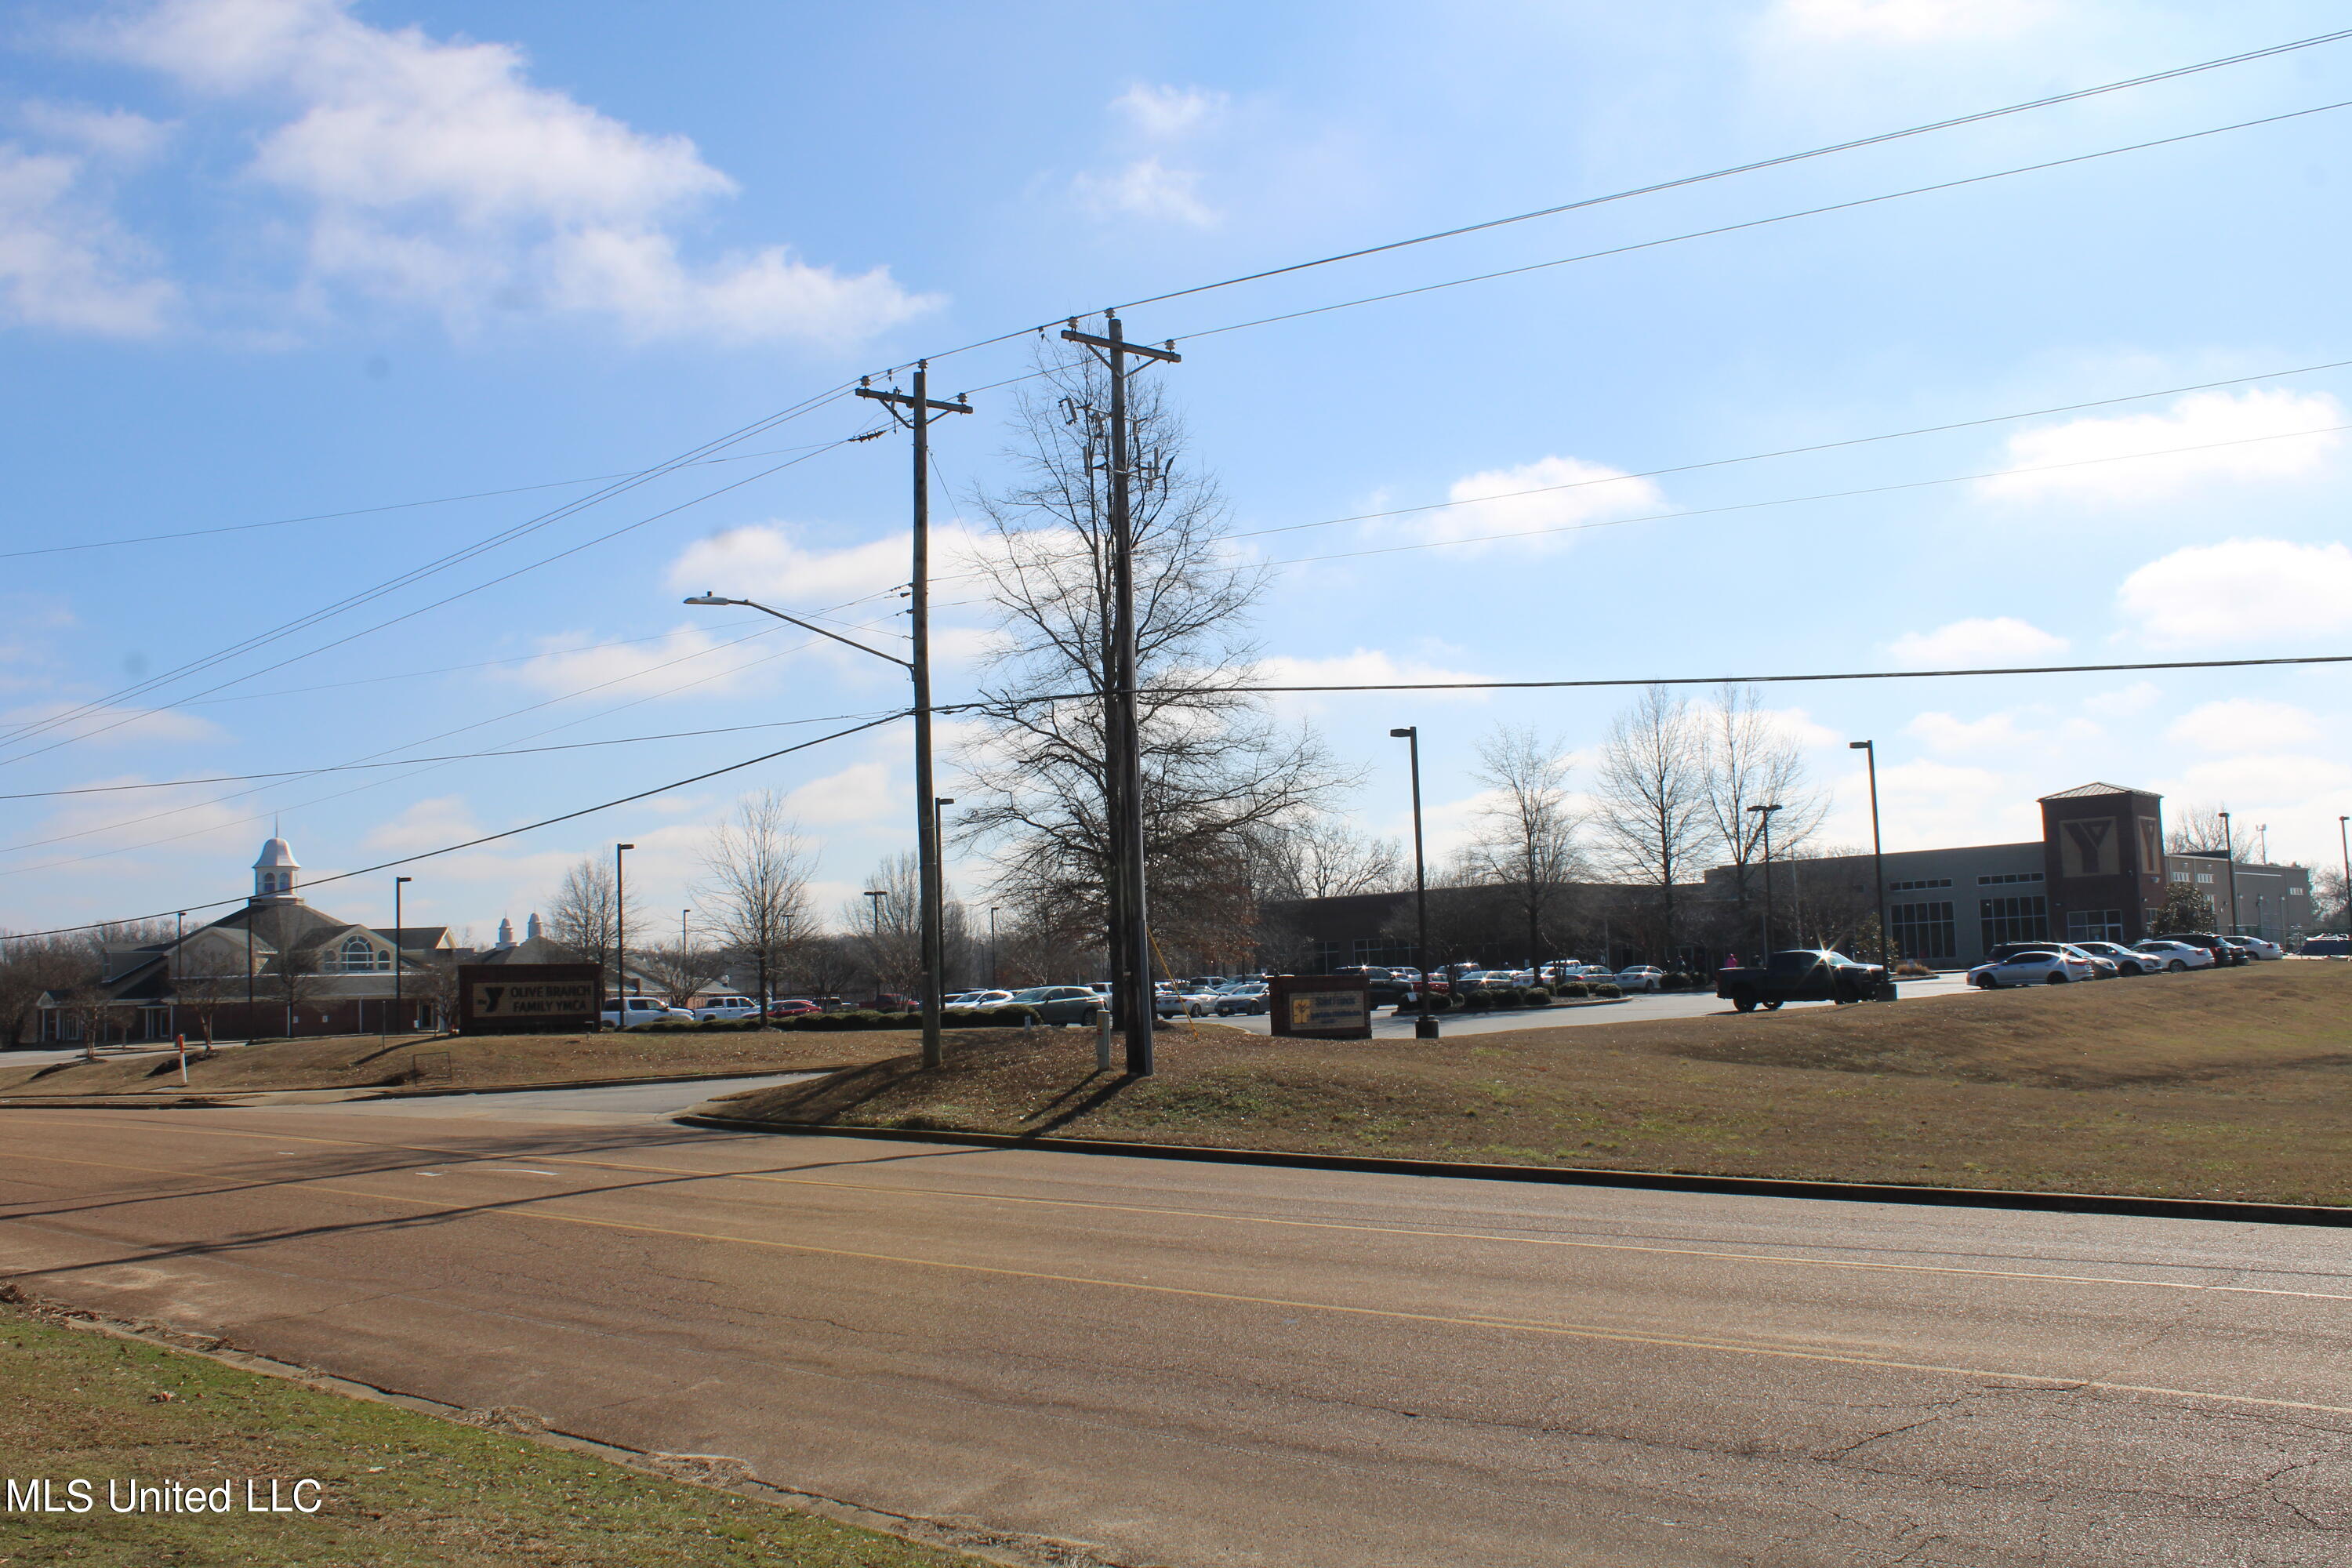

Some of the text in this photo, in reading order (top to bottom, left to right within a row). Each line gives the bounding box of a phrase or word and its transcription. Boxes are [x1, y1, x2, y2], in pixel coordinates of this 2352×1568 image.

[510, 985, 590, 998] OLIVE BRANCH
[514, 1000, 586, 1012] FAMILY YMCA
